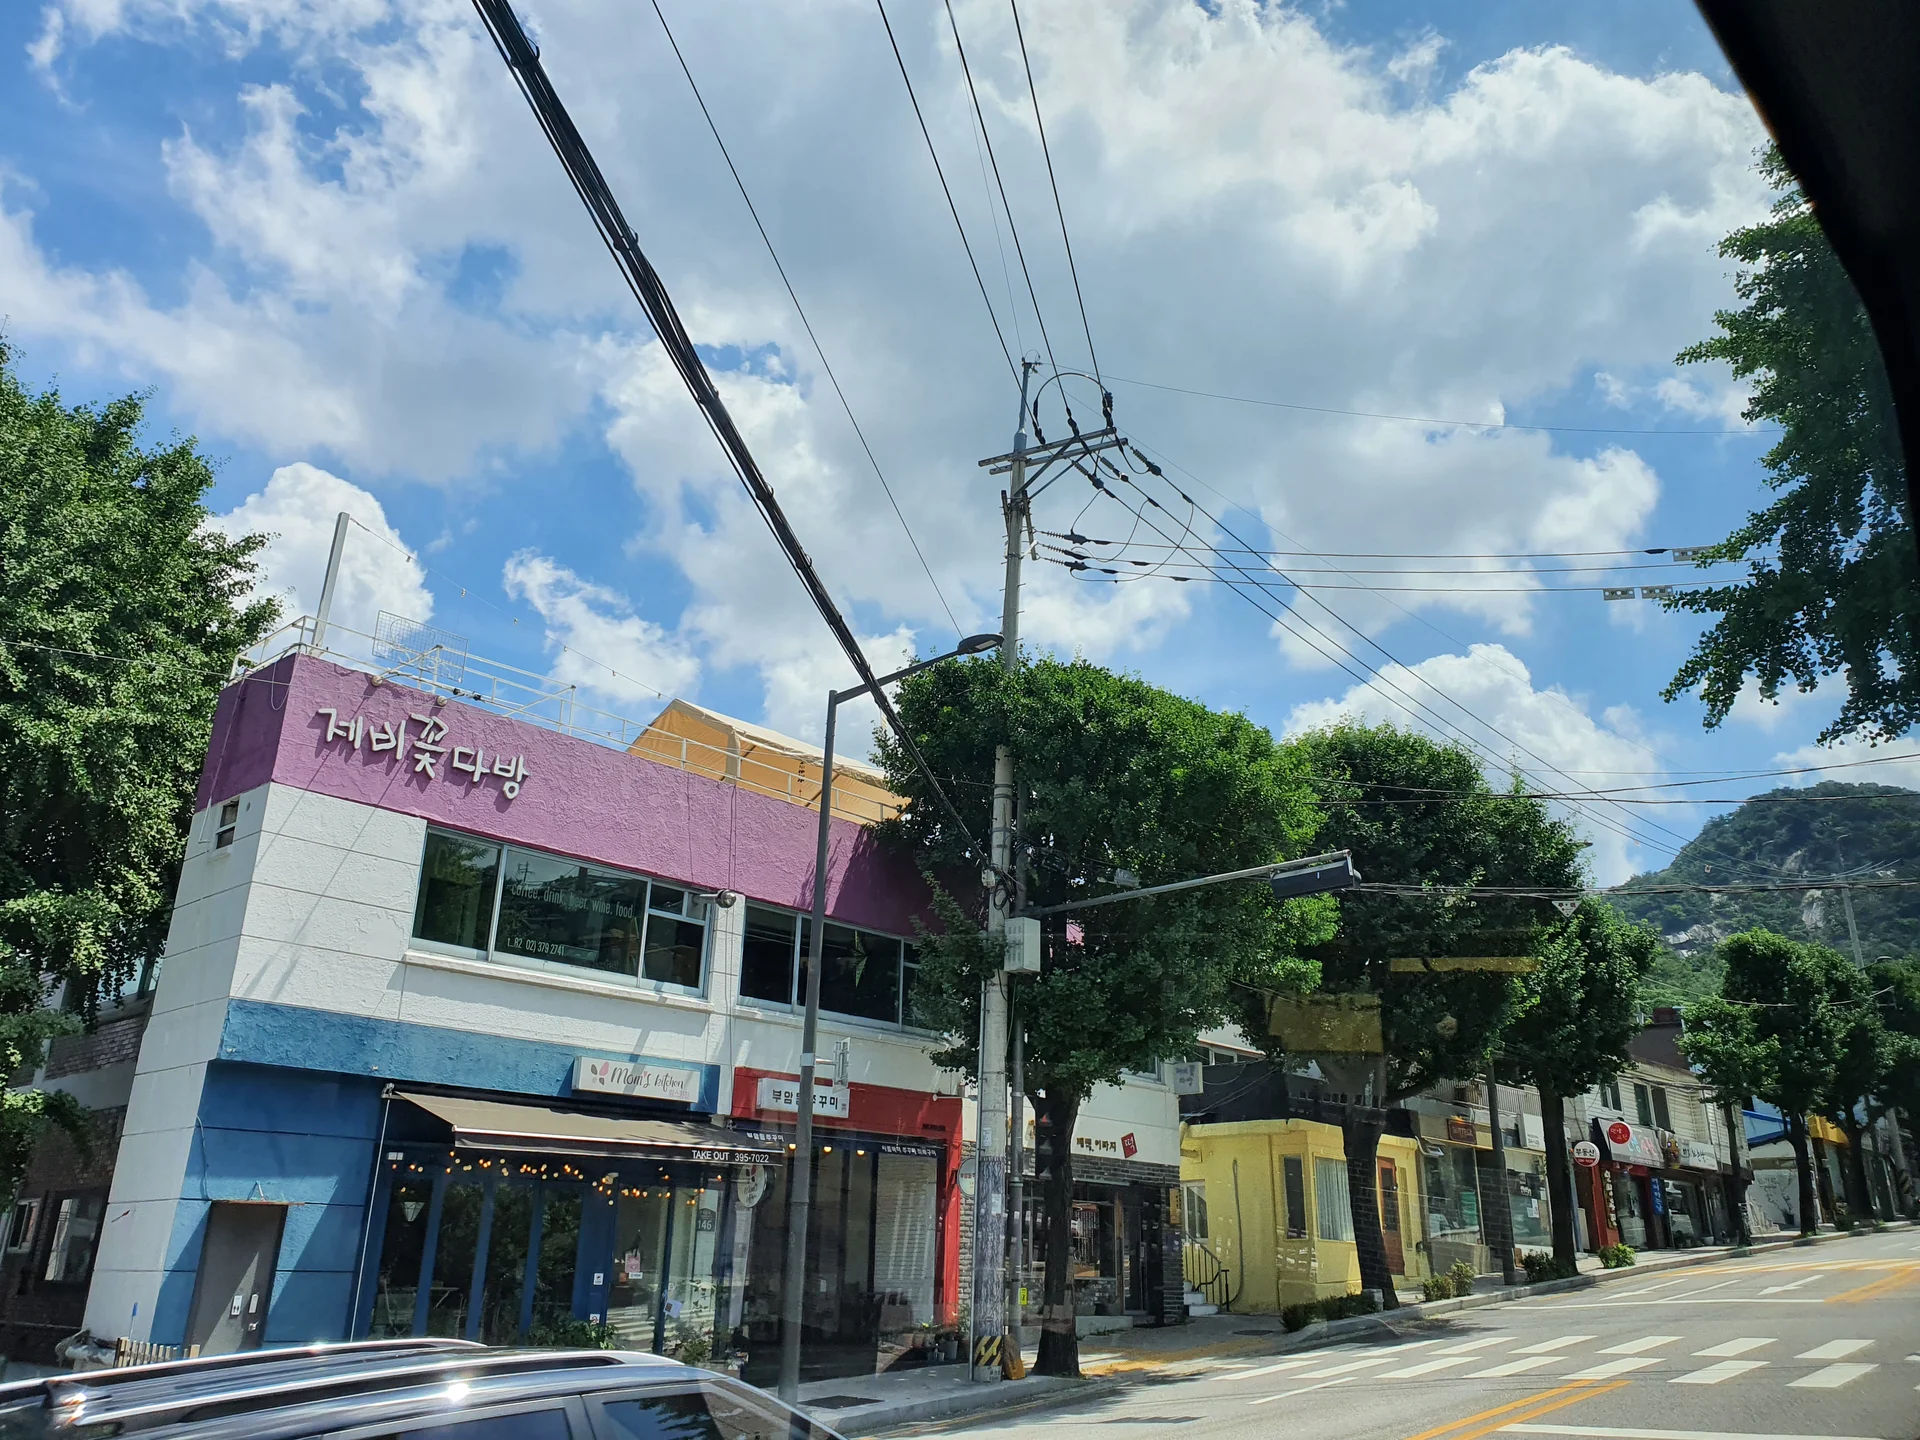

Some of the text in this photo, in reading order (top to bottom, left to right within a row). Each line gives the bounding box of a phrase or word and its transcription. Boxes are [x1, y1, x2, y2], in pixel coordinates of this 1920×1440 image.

[318, 708, 531, 800] 제비꽃다방
[592, 898, 613, 915] wine.
[525, 939, 537, 953] 02)
[537, 941, 550, 954] 379
[550, 943, 565, 956] 2741
[692, 1150, 769, 1163] TAKE OUT 395-7022
[1575, 1148, 1595, 1157] 부동산
[698, 1219, 712, 1230] 146
